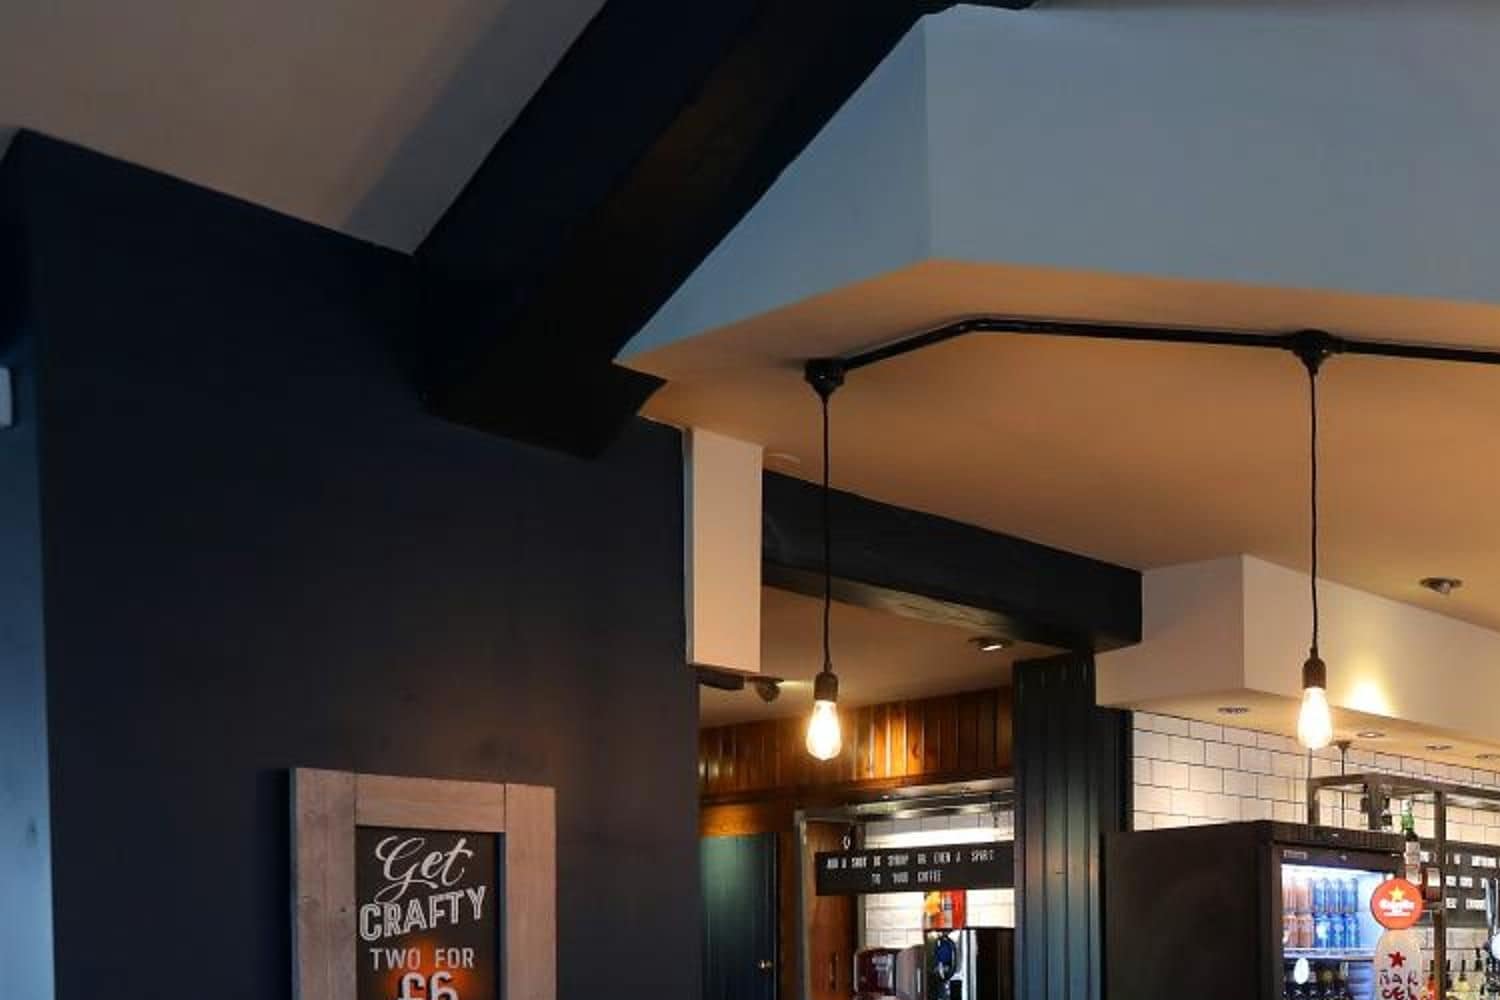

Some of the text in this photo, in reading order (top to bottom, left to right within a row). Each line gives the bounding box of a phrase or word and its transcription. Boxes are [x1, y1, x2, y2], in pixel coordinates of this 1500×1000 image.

[375, 836, 473, 904] Get
[360, 885, 487, 941] CRAFTY
[369, 947, 475, 971] TWO FOR
